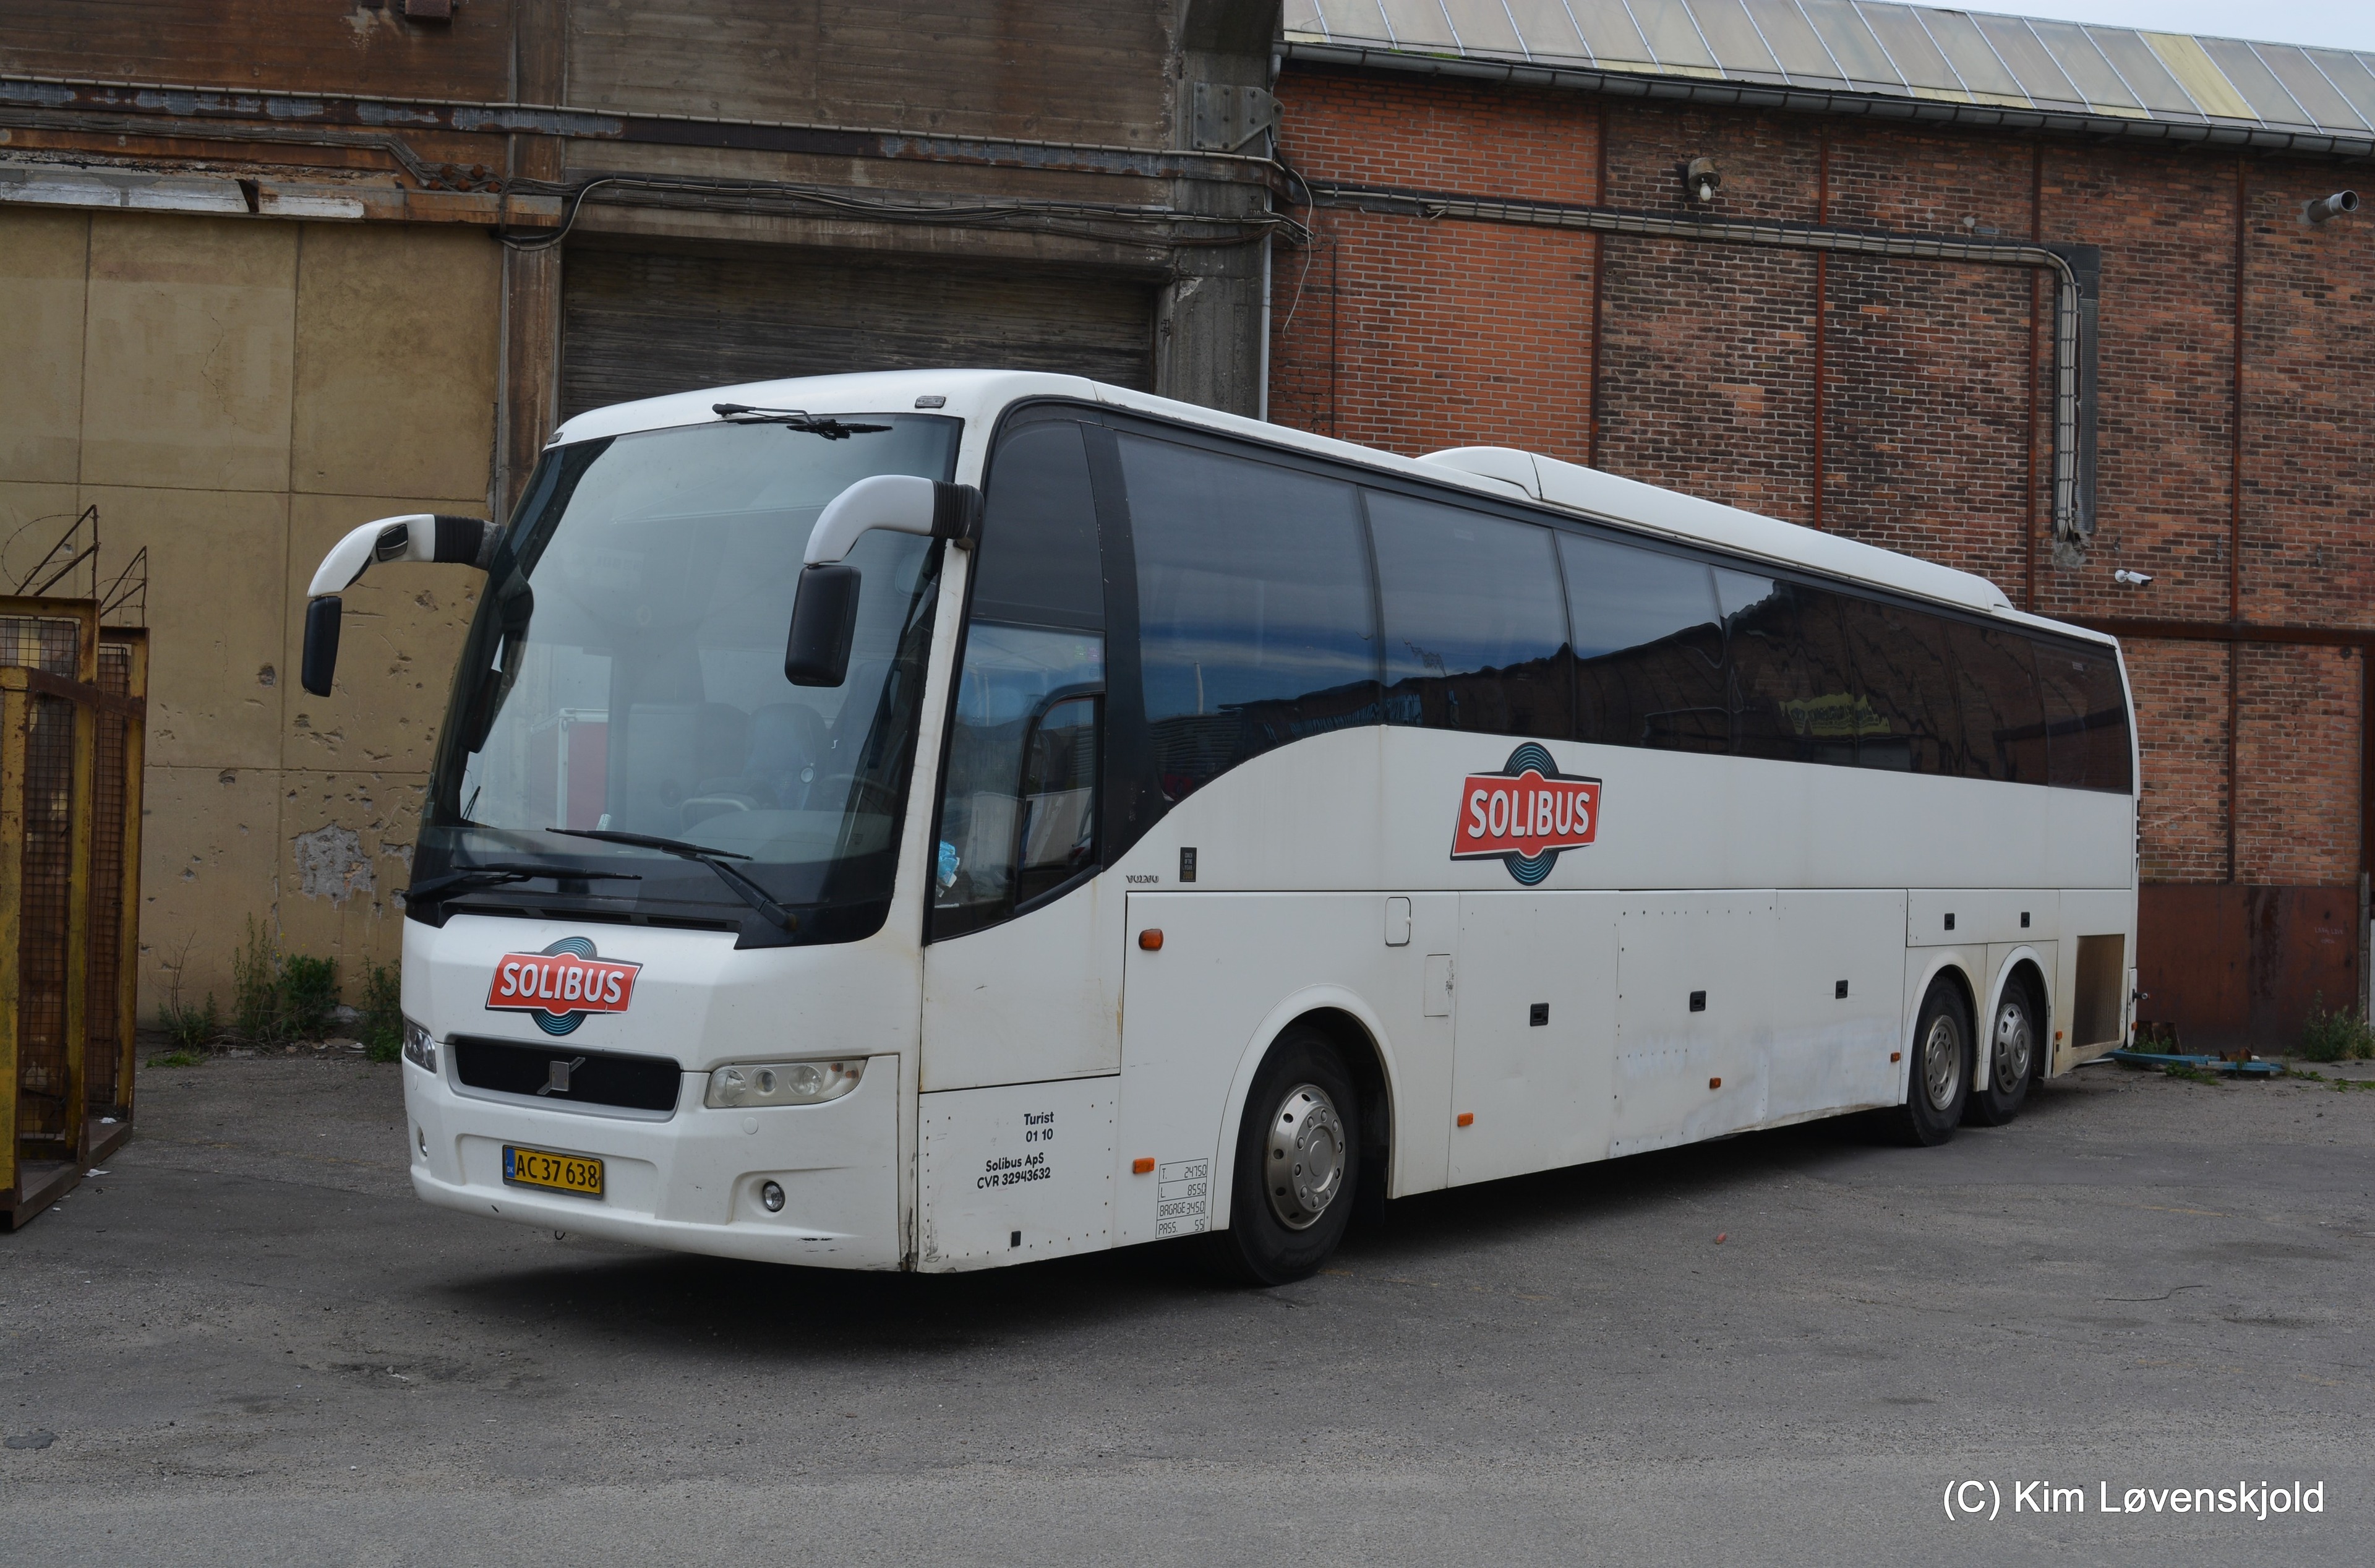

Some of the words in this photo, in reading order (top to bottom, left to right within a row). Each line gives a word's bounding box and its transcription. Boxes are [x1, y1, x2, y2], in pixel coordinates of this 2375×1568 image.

[1468, 789, 1590, 838] SOLIBUS
[1126, 875, 1159, 883] VOLVO
[500, 962, 625, 1004] SOLIBUS
[1024, 1112, 1054, 1126] Turist
[1026, 1130, 1038, 1142] 01
[1042, 1128, 1053, 1141] 10
[986, 1157, 1022, 1172] Solibus
[1025, 1152, 1044, 1168] ApS
[516, 1154, 537, 1178] AC
[541, 1158, 561, 1182] 37
[566, 1162, 598, 1188] 638
[977, 1175, 999, 1189] CVR
[1002, 1167, 1051, 1185] 32943632
[1184, 1164, 1207, 1178] 24750
[1188, 1182, 1206, 1196] 8550
[1160, 1202, 1186, 1217] BAGAGE
[1186, 1201, 1205, 1214] 3450
[1158, 1221, 1178, 1235] PASS.
[1194, 1219, 1204, 1231] 55
